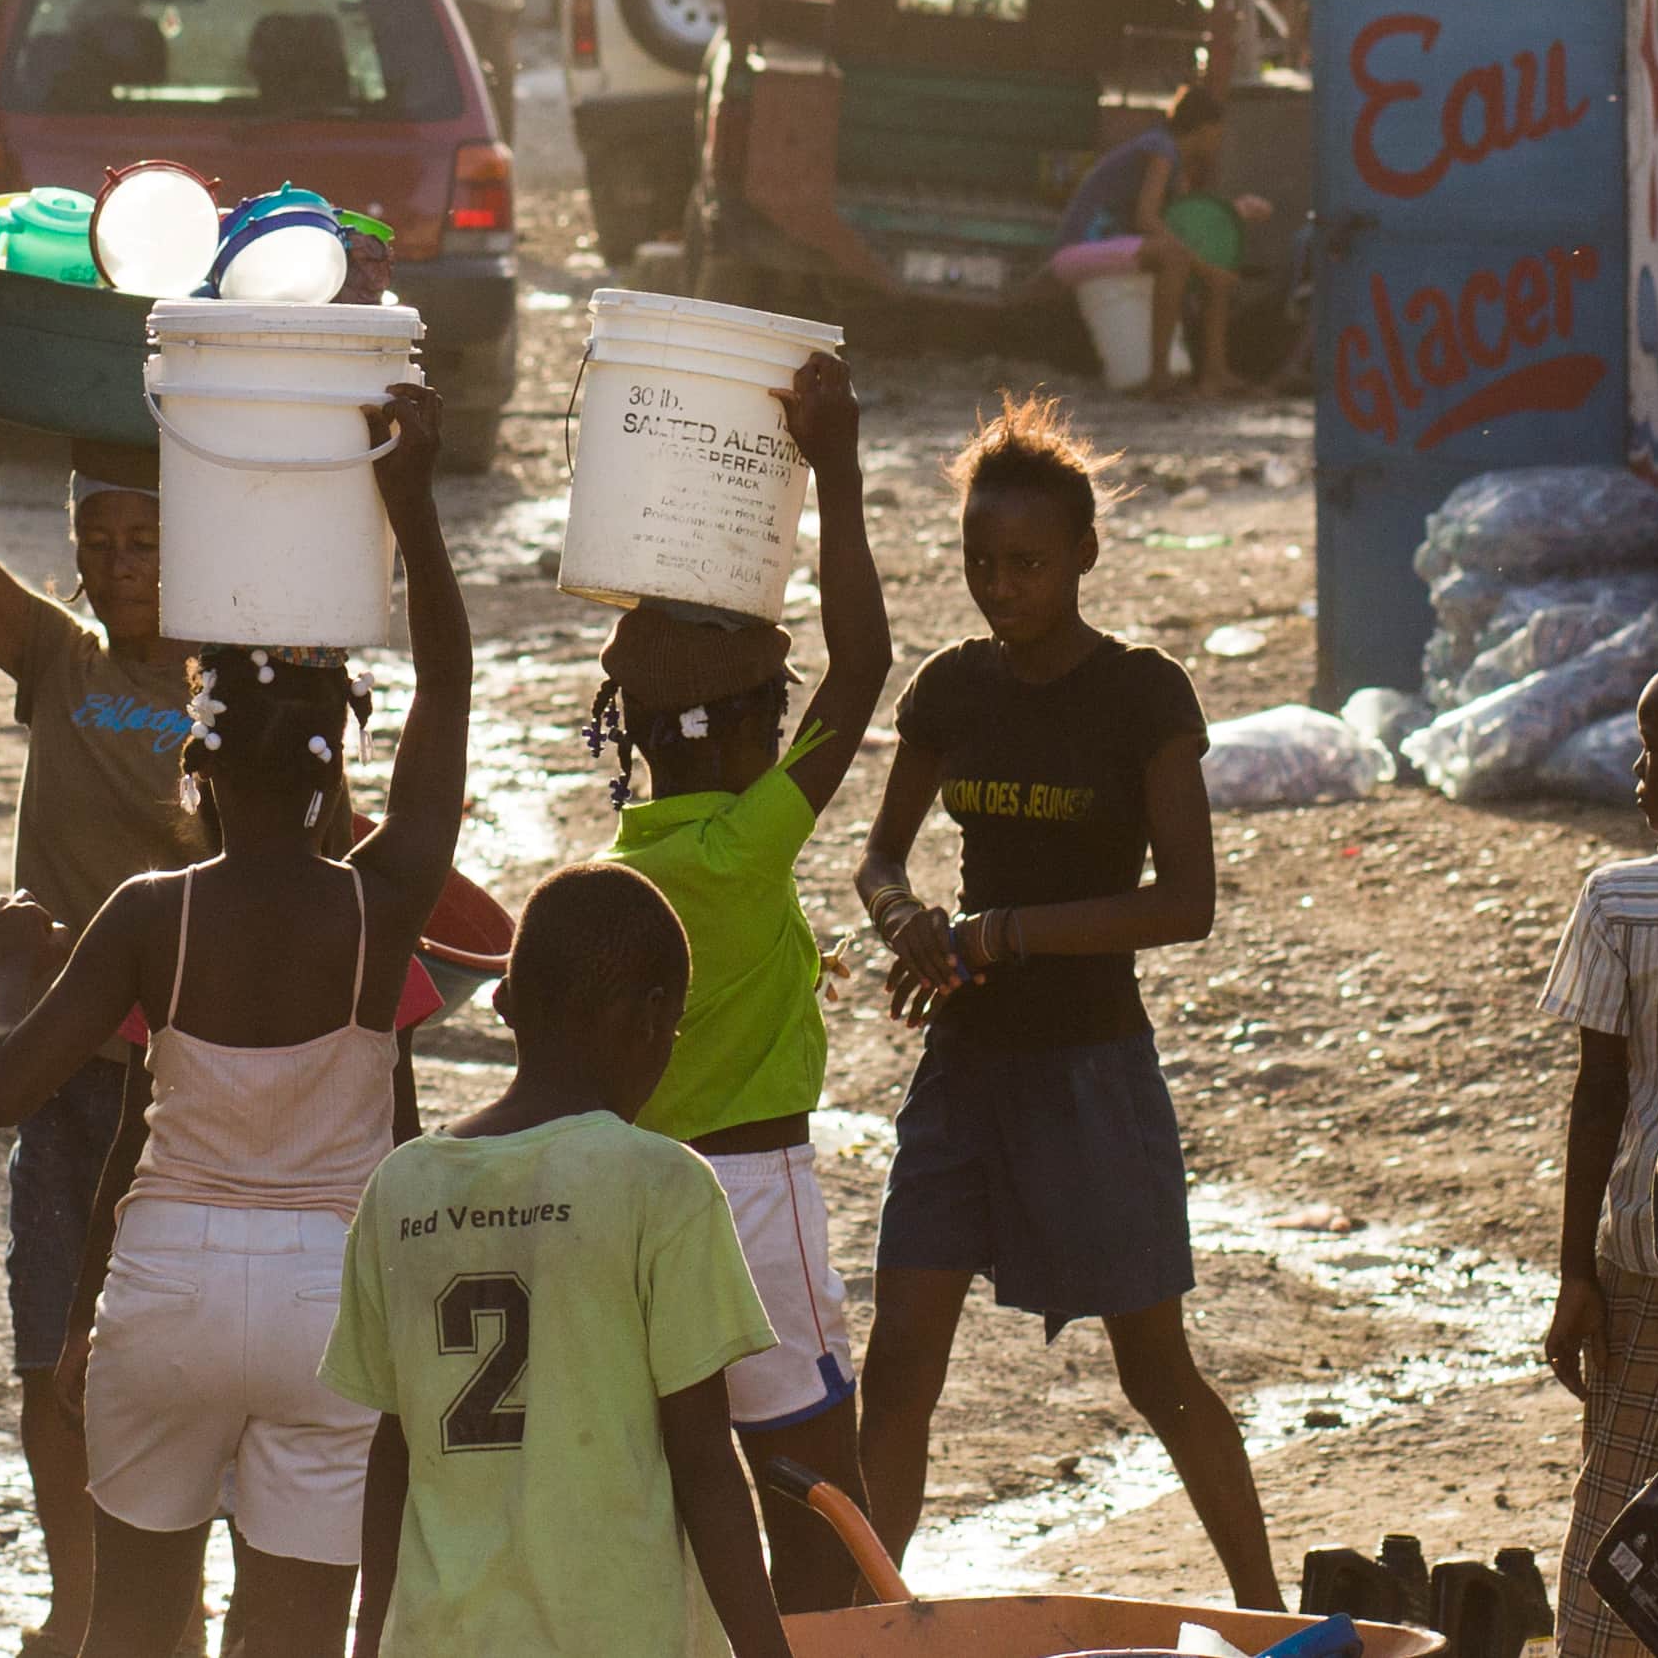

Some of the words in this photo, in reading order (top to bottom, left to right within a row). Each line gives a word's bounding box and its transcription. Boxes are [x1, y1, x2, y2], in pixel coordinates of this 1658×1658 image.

[1349, 12, 1590, 199] Eau
[1334, 245, 1600, 445] Glacer
[628, 385, 654, 407] 30
[659, 388, 684, 411] lb.
[726, 473, 761, 493] PACK
[700, 558, 762, 585] CADA
[985, 781, 1021, 817] DES
[400, 1209, 439, 1242] Red
[446, 1202, 572, 1231] Ventures
[433, 1270, 532, 1455] 2
